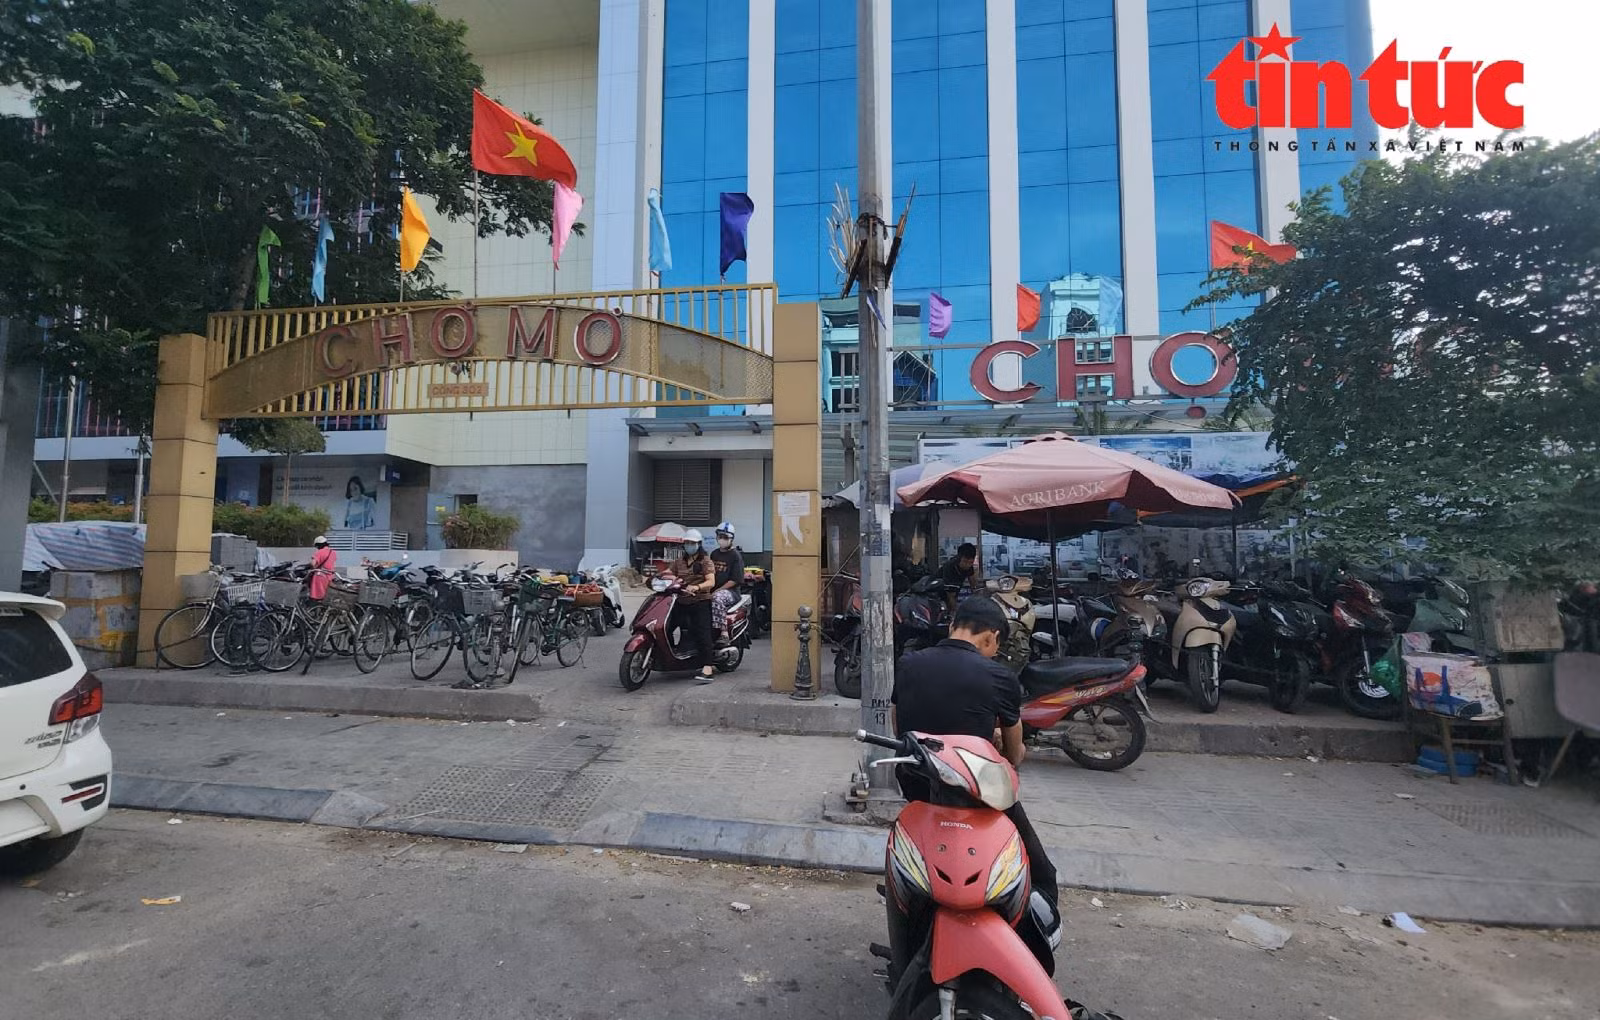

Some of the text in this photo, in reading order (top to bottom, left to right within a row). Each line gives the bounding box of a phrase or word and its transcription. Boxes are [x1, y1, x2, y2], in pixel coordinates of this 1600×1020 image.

[506, 305, 624, 365] MƠ
[1010, 480, 1107, 507] AGRIBANK
[874, 712, 886, 725] 13
[940, 821, 974, 830] HONDA
